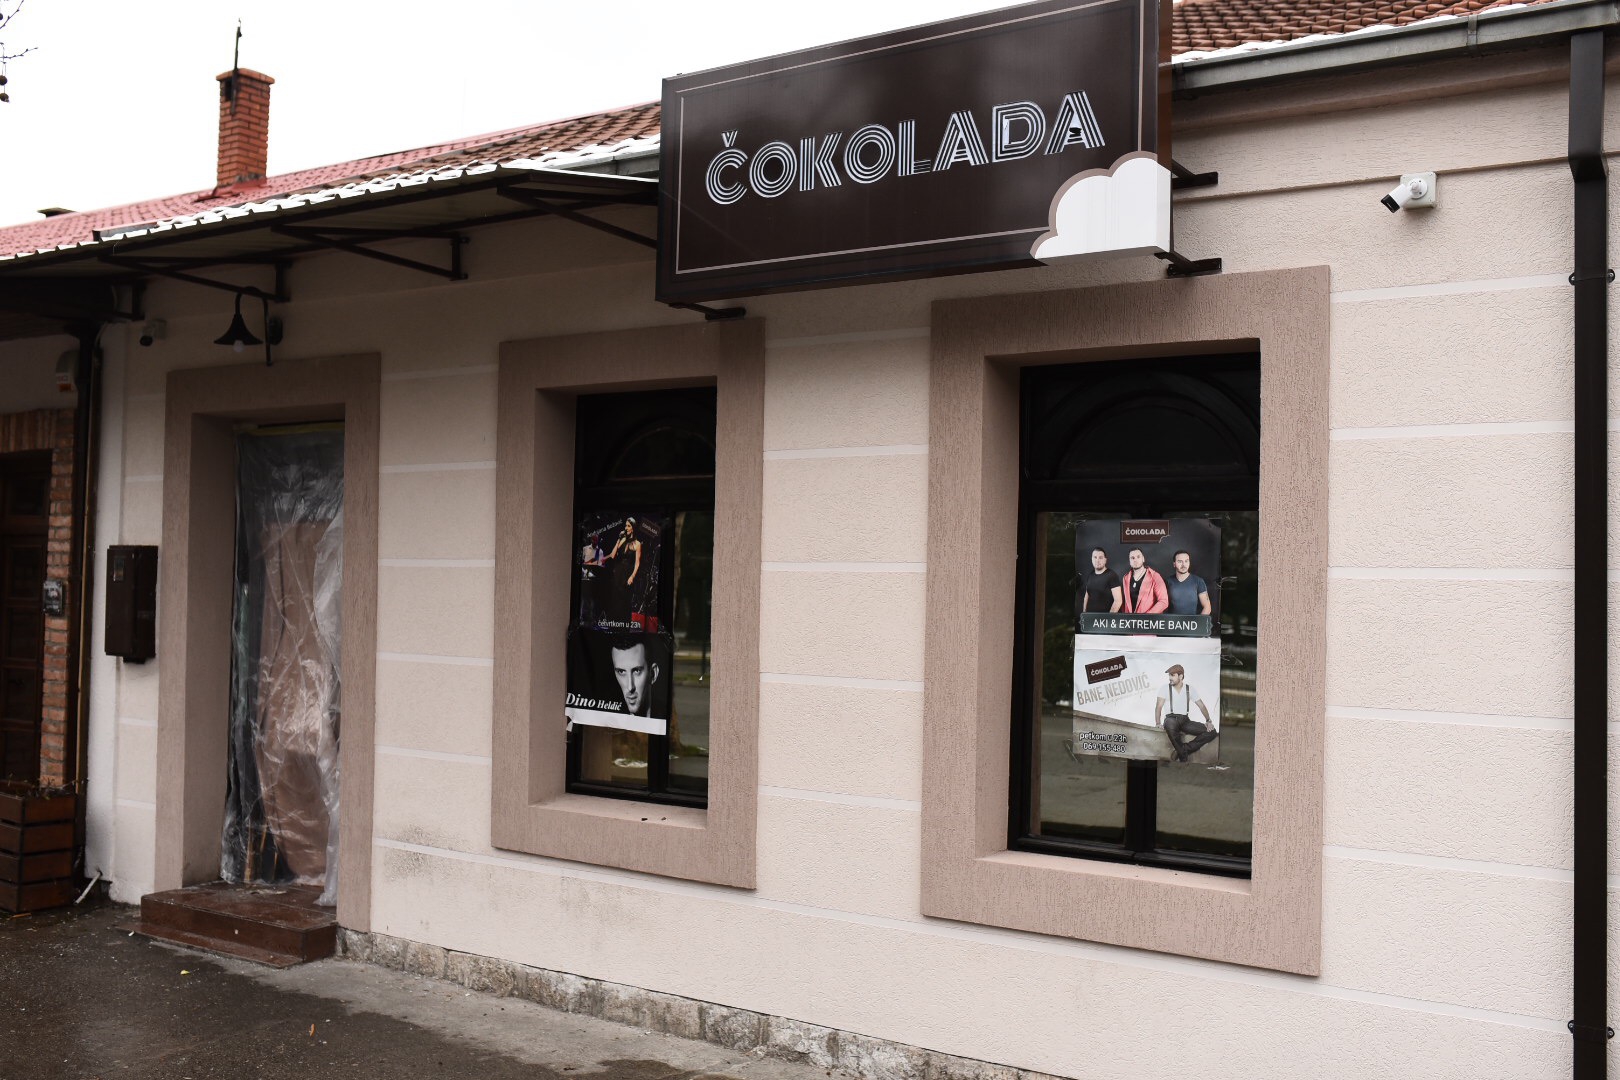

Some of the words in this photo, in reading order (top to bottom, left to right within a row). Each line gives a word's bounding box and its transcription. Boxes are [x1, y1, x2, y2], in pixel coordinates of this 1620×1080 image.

[705, 90, 1105, 204] ČOKOLADA
[1125, 527, 1166, 536] ČOKOLADA
[630, 620, 641, 629] 23h
[1093, 619, 1109, 628] AKI
[1110, 619, 1117, 628] &
[1119, 619, 1165, 630] EXTREME
[1168, 620, 1198, 631] BAND
[1076, 686, 1105, 706] BANE
[1104, 672, 1150, 699] NEDOVIĆ
[566, 692, 596, 708] Dino
[1079, 732, 1106, 742] petkom
[1114, 734, 1127, 744] 23h
